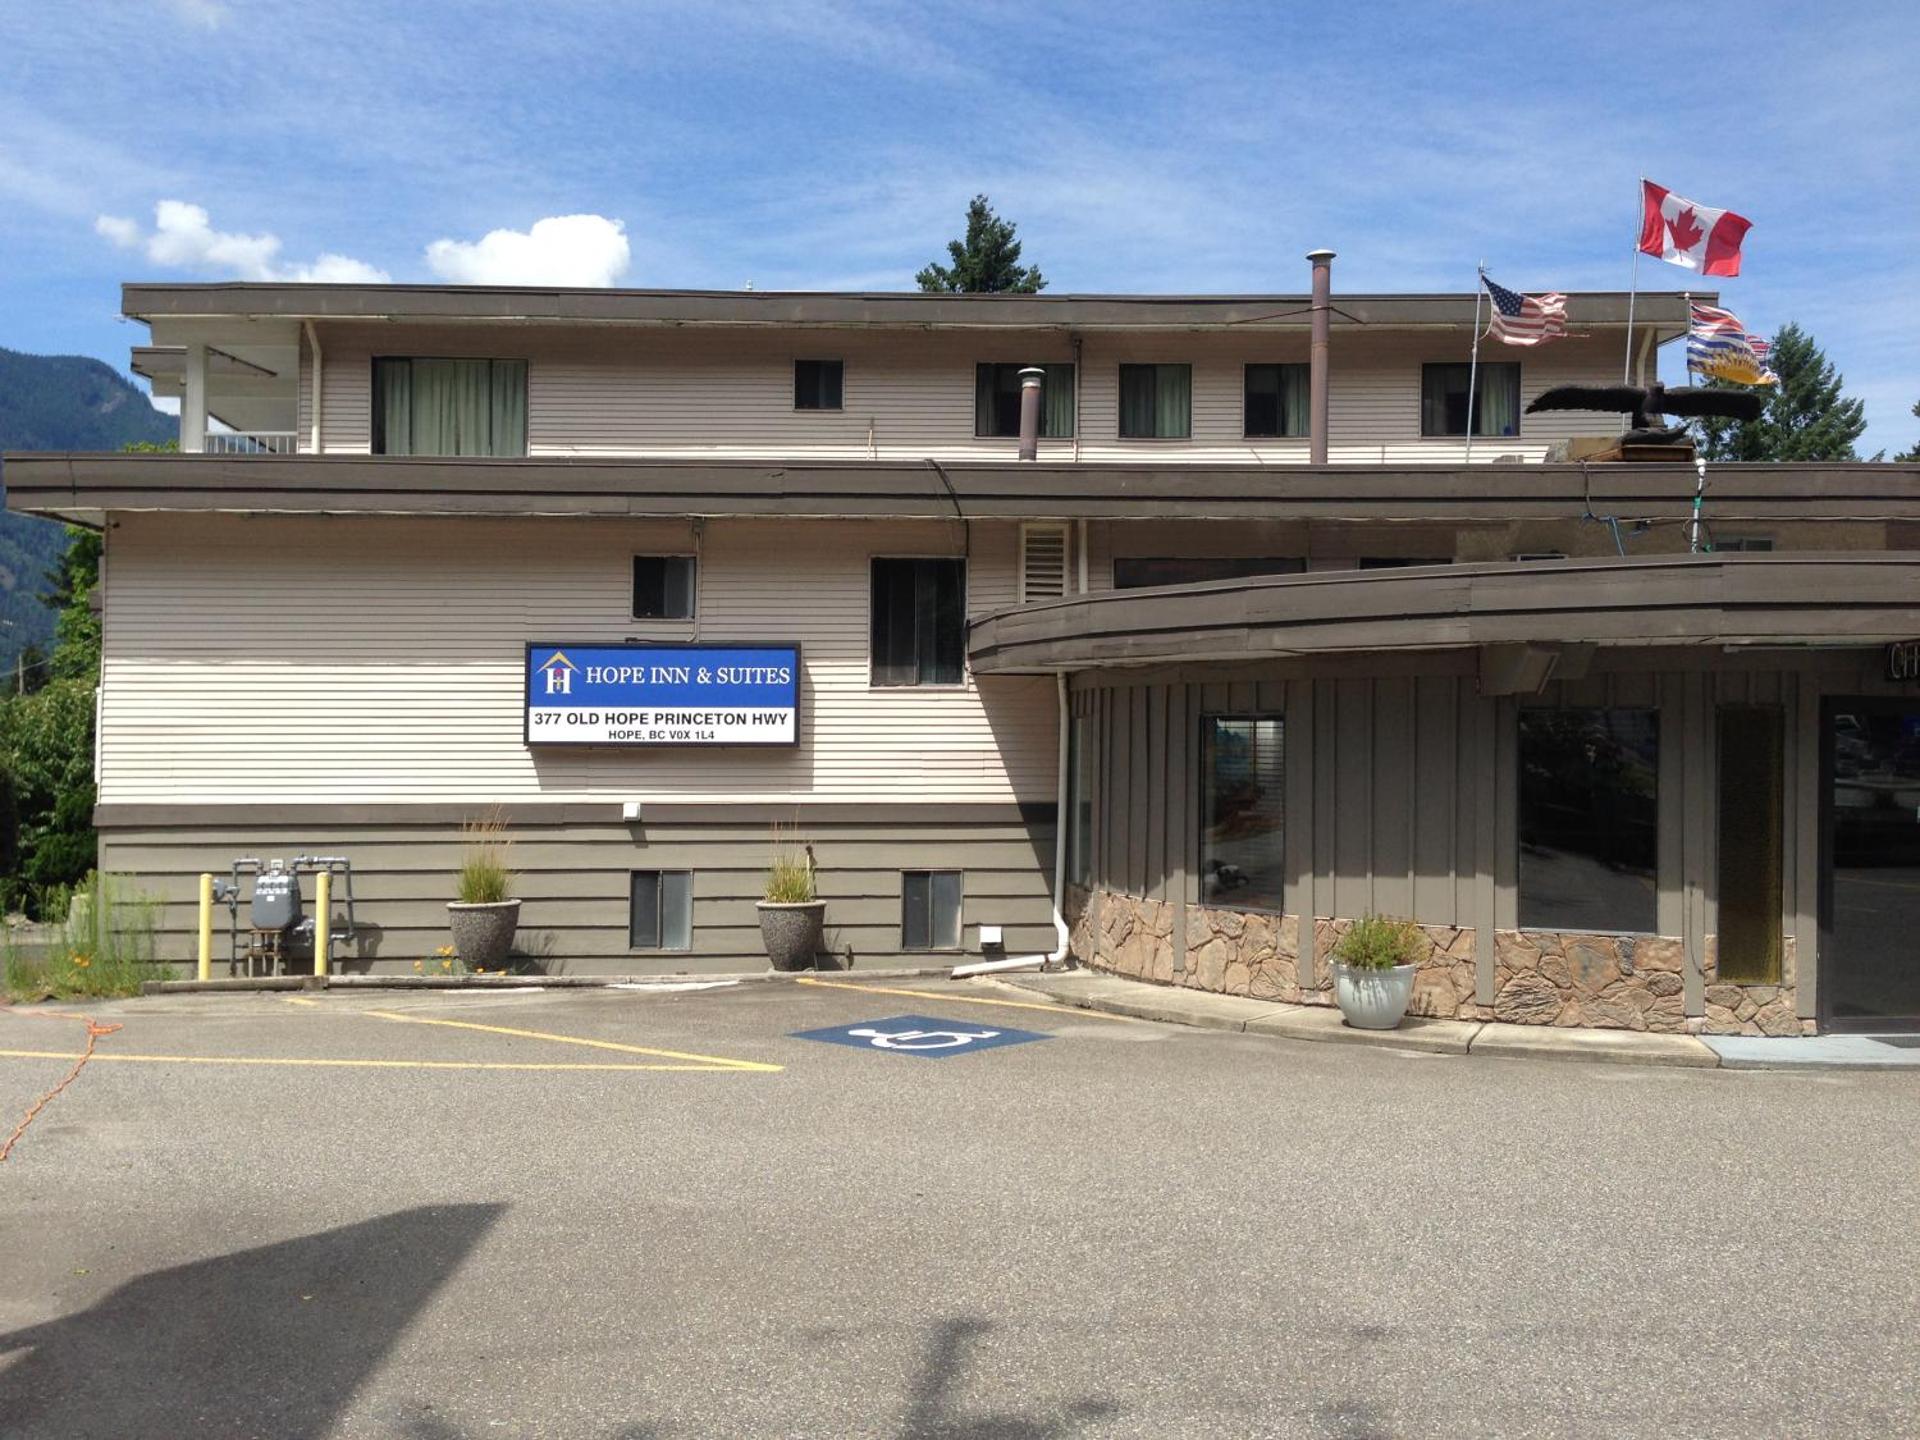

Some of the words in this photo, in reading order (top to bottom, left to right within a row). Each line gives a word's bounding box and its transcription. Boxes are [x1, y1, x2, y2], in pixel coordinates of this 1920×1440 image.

[586, 666, 645, 685] HOPE
[650, 666, 690, 685] INN
[696, 666, 712, 685] &
[716, 666, 791, 685] SUITES
[534, 712, 562, 725] 377
[566, 712, 600, 725] OLD
[604, 712, 649, 725] HOPE
[654, 712, 747, 726] PRINCETON
[752, 712, 788, 726] HWY
[608, 730, 646, 741] HOPE,
[648, 730, 666, 740] BC
[695, 730, 715, 740] 1L4
